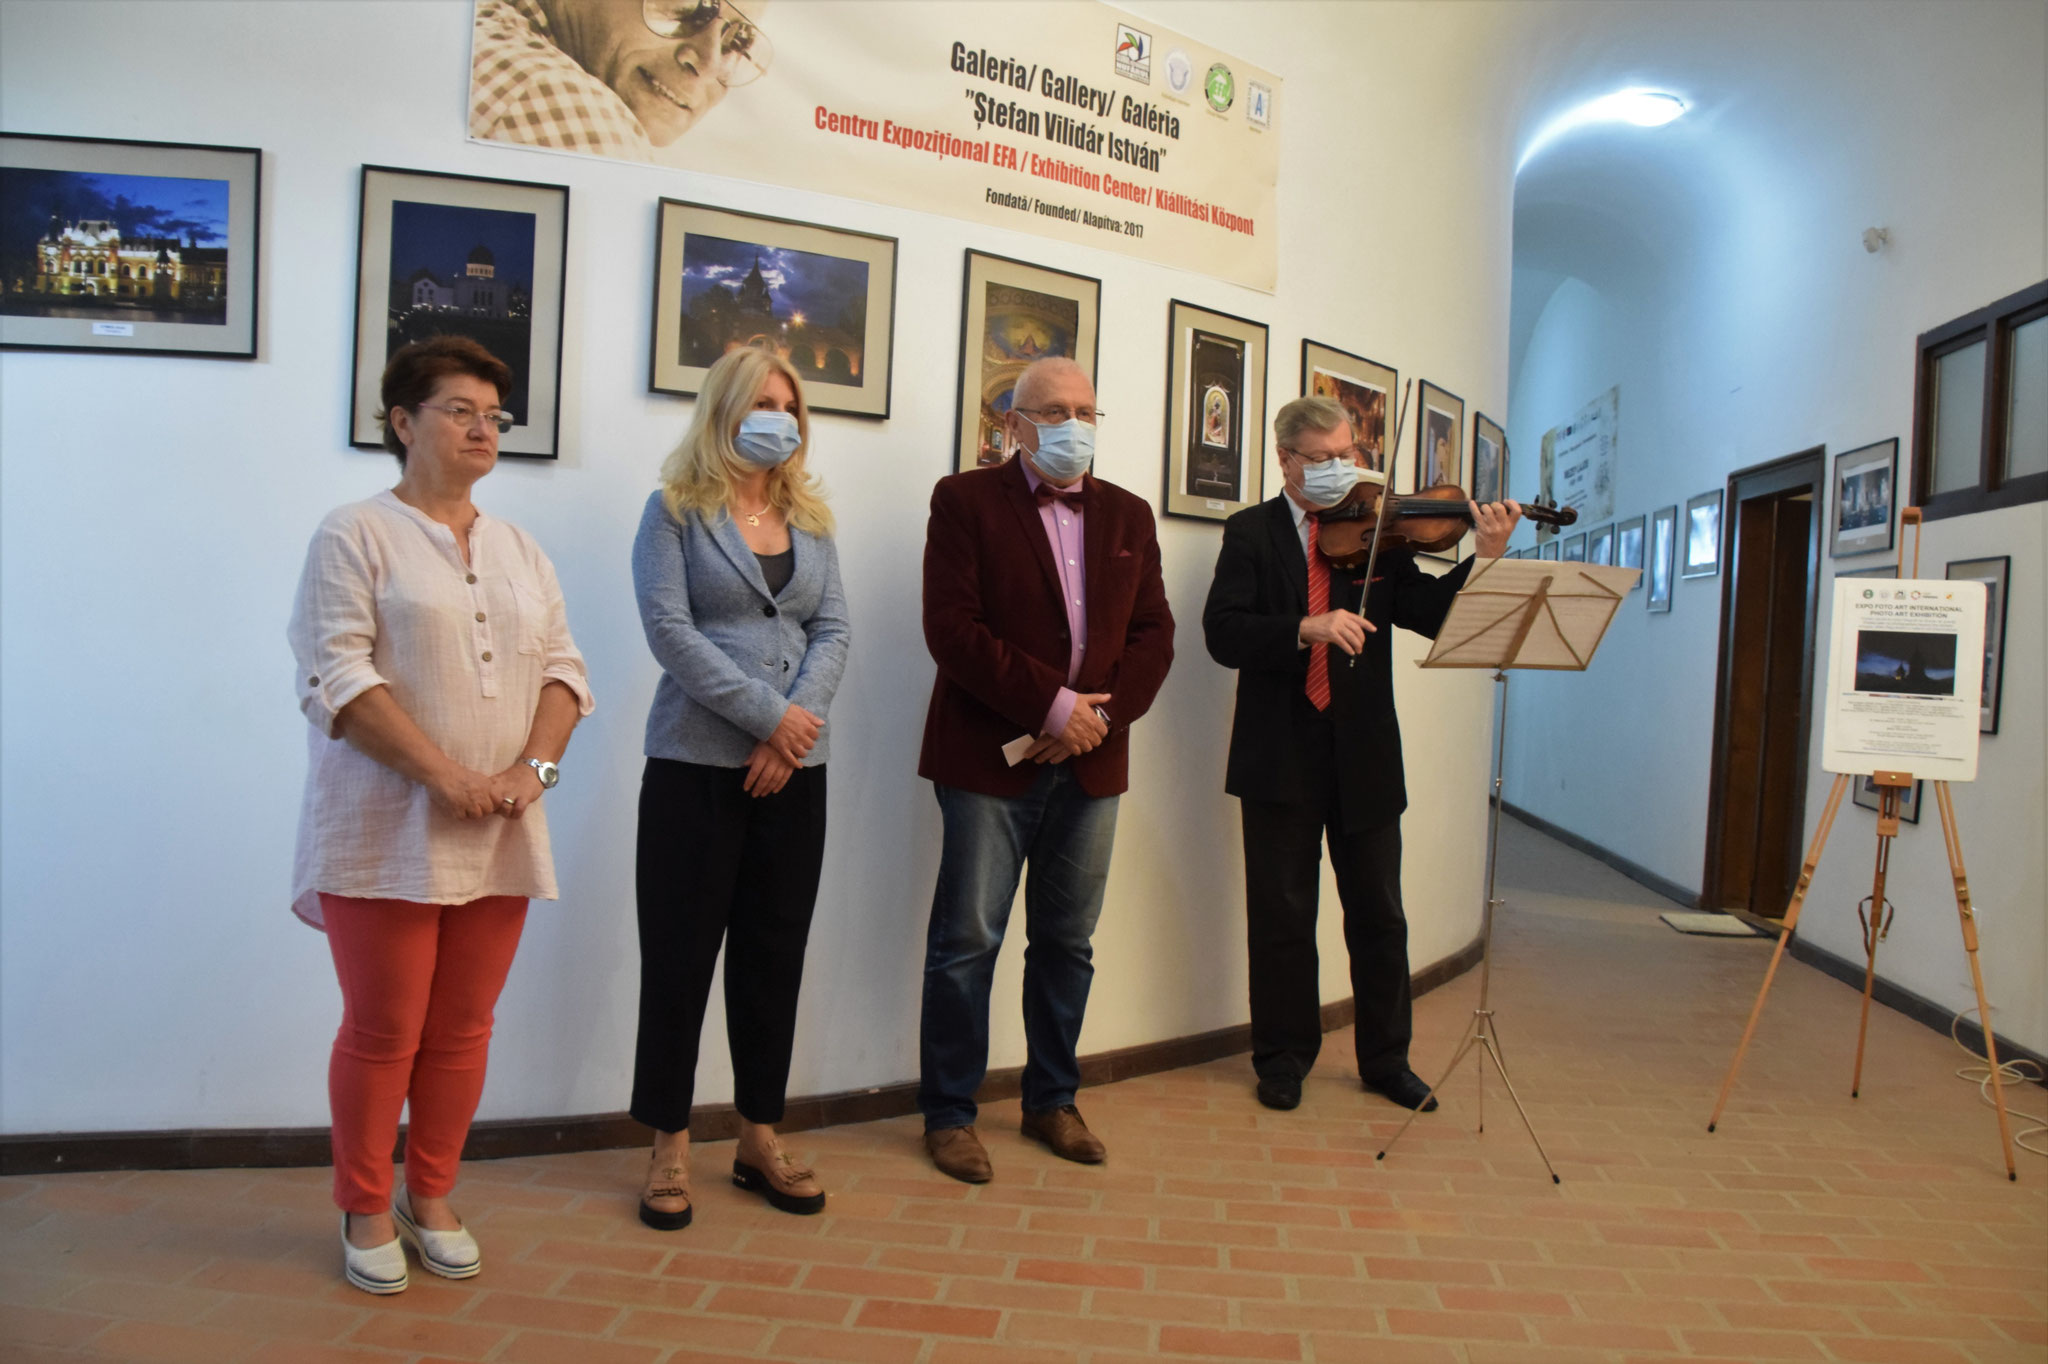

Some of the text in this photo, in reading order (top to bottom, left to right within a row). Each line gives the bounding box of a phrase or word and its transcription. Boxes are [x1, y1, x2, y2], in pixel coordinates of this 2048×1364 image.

[950, 41, 1180, 140] Galeria/ Gallery/ Galéria
[815, 105, 879, 141] Centru
[882, 119, 990, 164] Expozițional
[993, 143, 1017, 171] EFA
[1031, 153, 1100, 192] Exhibition
[1103, 173, 1152, 206] Center/
[1155, 188, 1209, 222] Kiállítási
[1211, 204, 1254, 236] Központ
[1044, 111, 1105, 155] Vilidár
[986, 187, 1033, 212] Fondată/
[1034, 199, 1082, 223] Founded/
[1124, 221, 1144, 238] 2017
